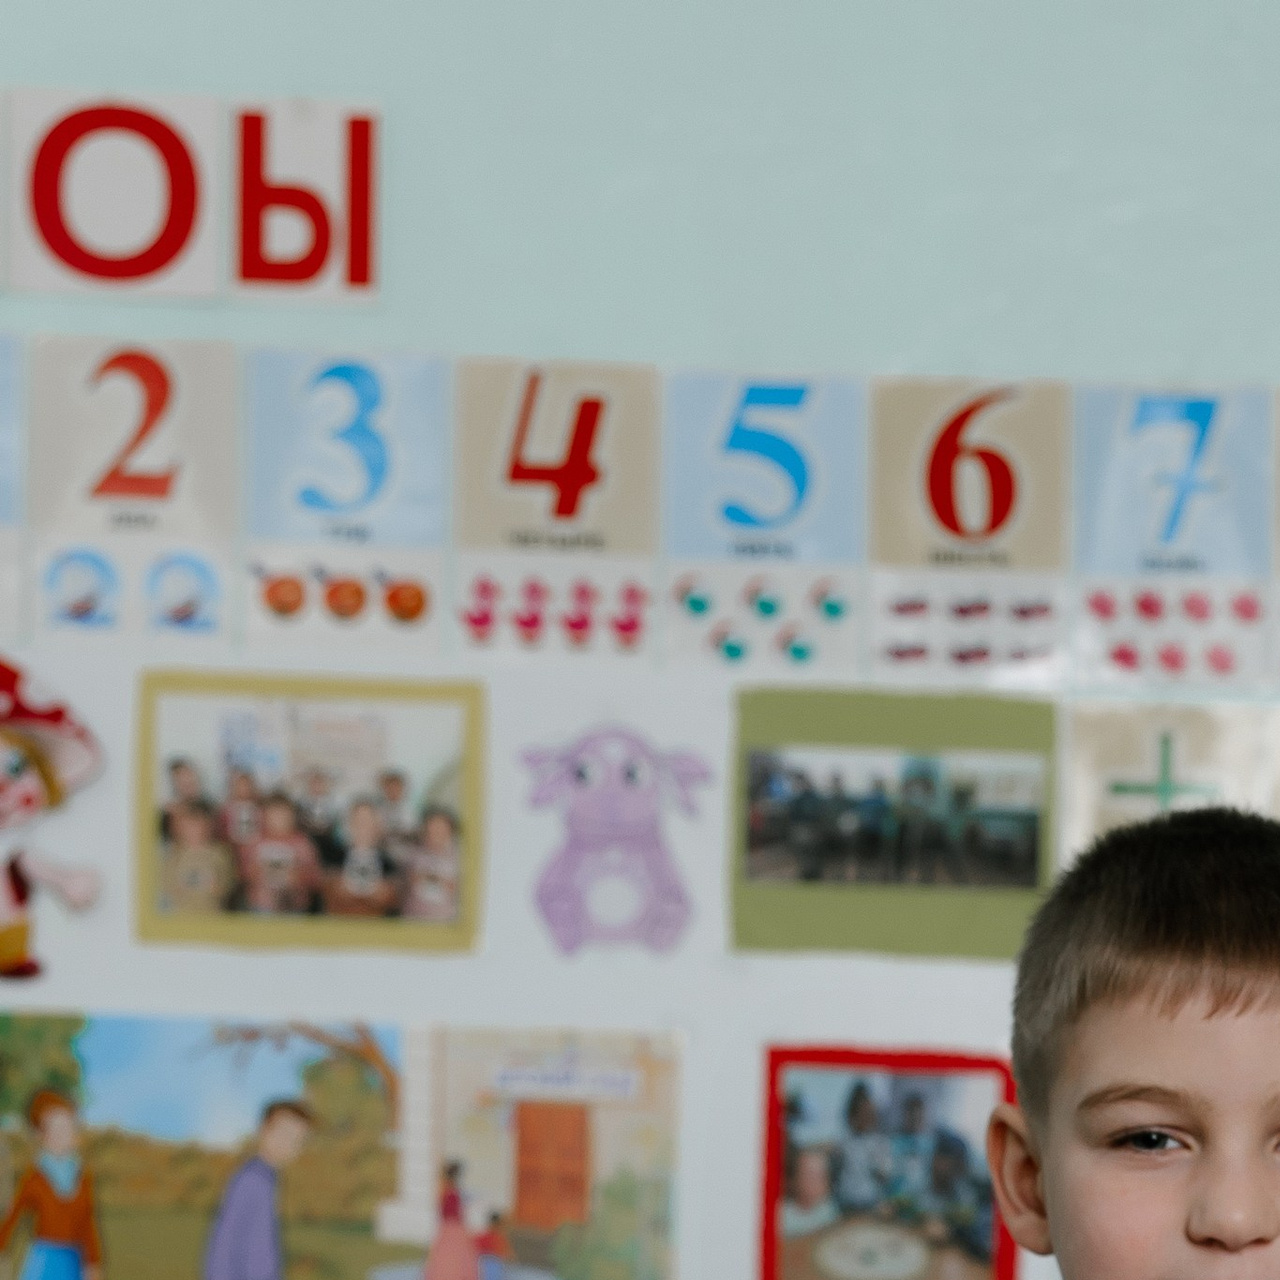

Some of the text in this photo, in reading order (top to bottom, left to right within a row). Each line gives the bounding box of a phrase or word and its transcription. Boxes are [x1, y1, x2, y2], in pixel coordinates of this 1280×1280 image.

[90, 349, 179, 500] 2
[298, 364, 390, 512] 3
[506, 370, 606, 520] 4
[722, 386, 812, 530] 5
[926, 388, 1016, 543] 6
[1129, 398, 1219, 543] 7
